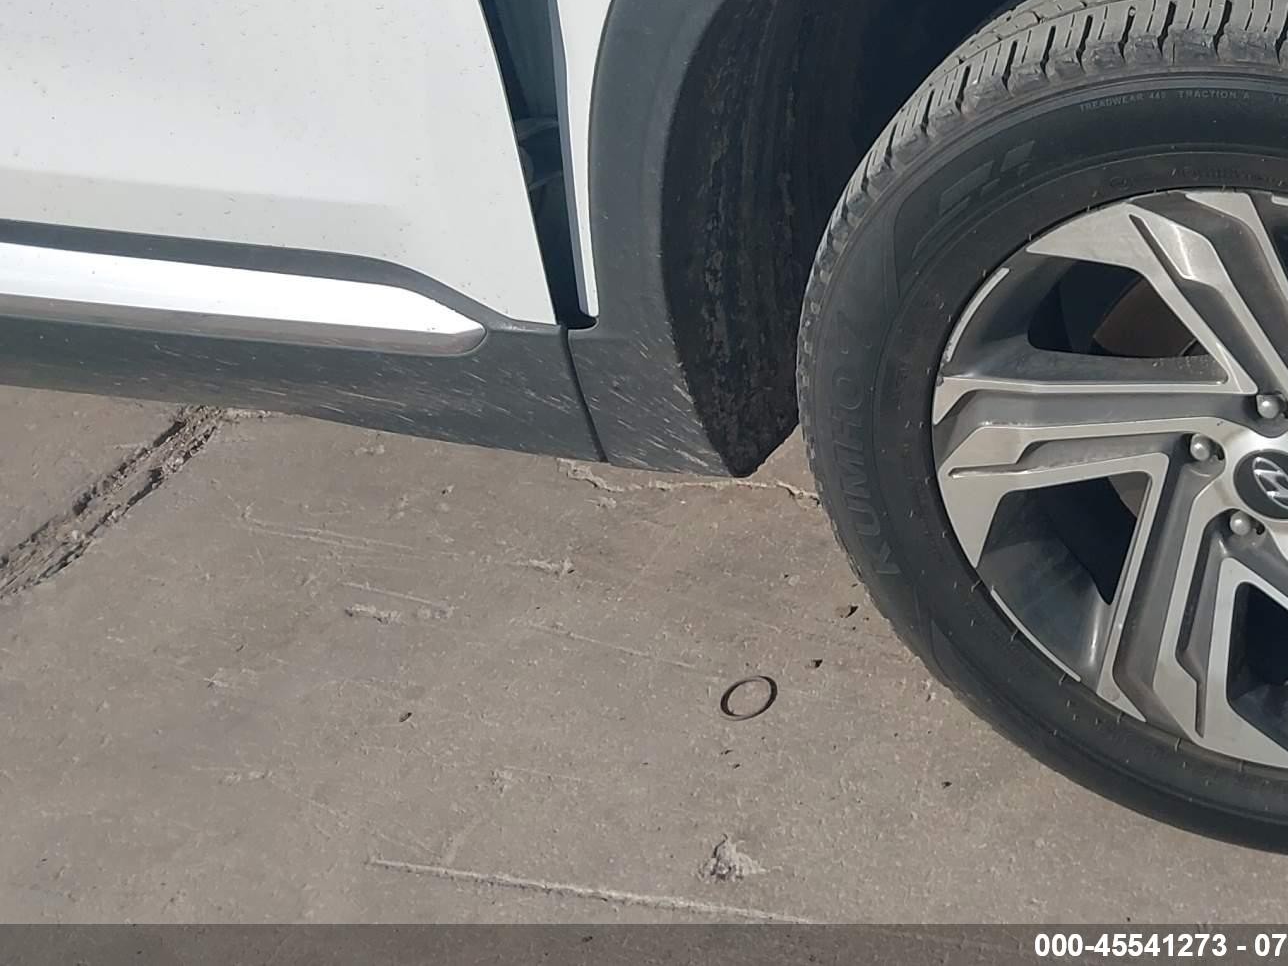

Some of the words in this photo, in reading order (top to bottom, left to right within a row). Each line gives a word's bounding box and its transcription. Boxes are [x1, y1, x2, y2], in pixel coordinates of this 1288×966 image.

[1079, 92, 1145, 113] TREADWEAR
[1177, 89, 1237, 100] TRACTION
[831, 367, 902, 576] KUMHO
